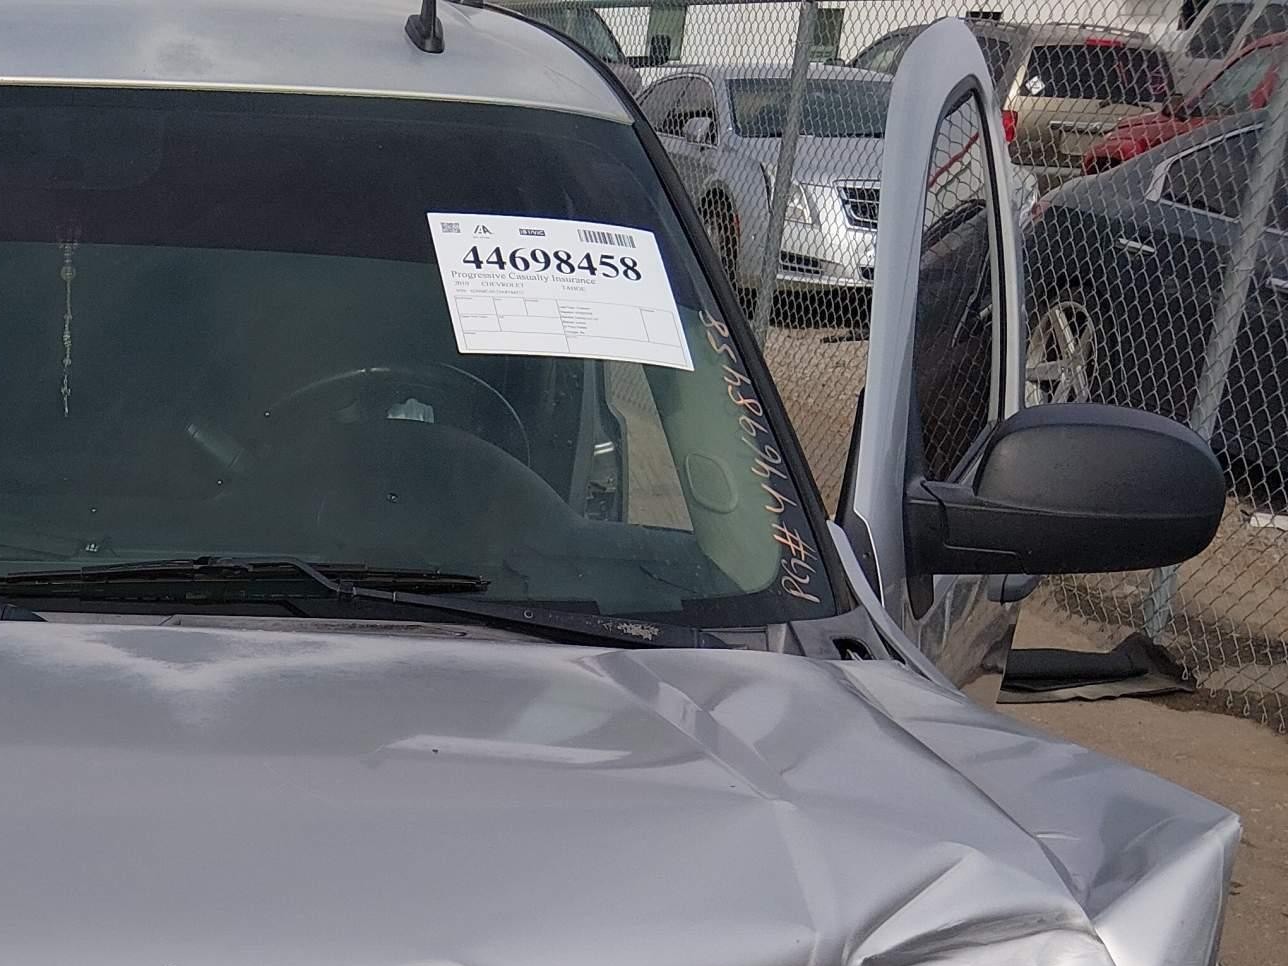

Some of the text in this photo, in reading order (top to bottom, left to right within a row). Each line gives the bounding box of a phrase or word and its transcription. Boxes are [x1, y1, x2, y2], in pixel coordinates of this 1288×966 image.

[462, 245, 642, 281] 44698458
[451, 271, 597, 285] Progressive Casualty Insurance
